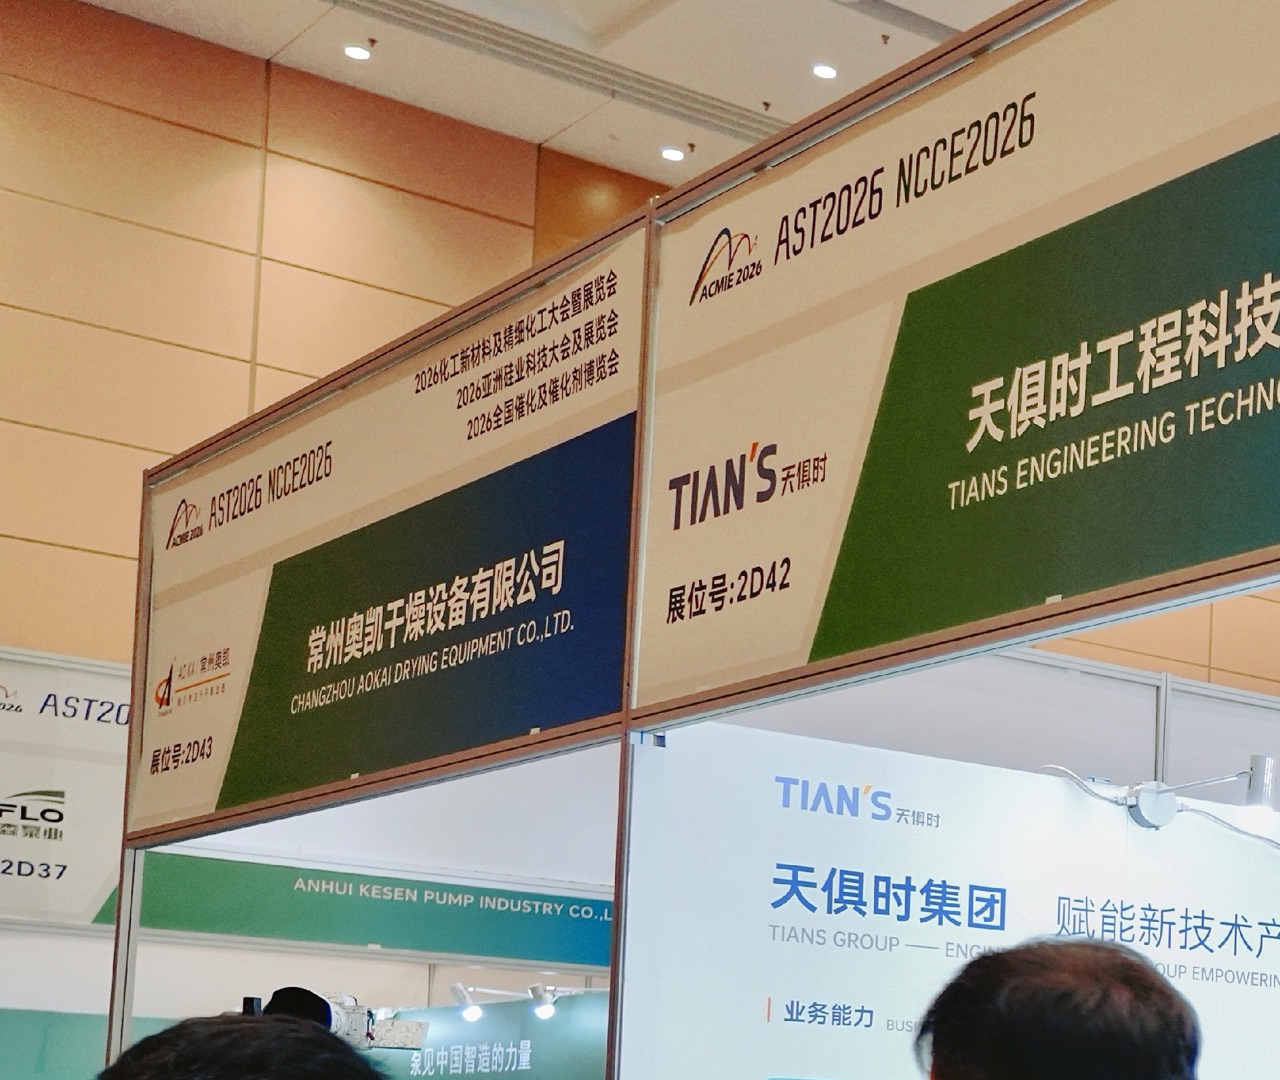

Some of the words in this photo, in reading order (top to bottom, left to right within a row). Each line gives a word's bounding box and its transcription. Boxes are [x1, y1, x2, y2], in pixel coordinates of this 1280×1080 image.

[774, 167, 887, 266] AST2026
[896, 91, 1037, 209] NCCE2026
[699, 276, 734, 303] ACMIE
[735, 260, 763, 288] 2026
[456, 309, 619, 409] 2026亚洲硅业科技大会及展览会
[467, 348, 620, 440] 2026全国催化及催化剂博览会
[208, 474, 263, 531] AST2026
[268, 440, 333, 504] NCCE2026
[780, 451, 828, 497] 天俱时
[948, 466, 1008, 510] TIANS
[1015, 410, 1176, 490] ENGINEERING
[306, 539, 565, 674] 常州奥凯干燥设备有限公司
[665, 556, 792, 625] 展位号:2D42
[290, 678, 355, 715] CHANGZHOU
[356, 664, 392, 693] AOKAI
[394, 651, 438, 684] DRYING
[441, 626, 515, 670] EQUIPMENT
[516, 609, 575, 646] CO.,LTD.
[150, 735, 213, 776] 展位号:2D43
[895, 807, 941, 829] 天俱时
[1, 859, 68, 880] 2D37
[293, 877, 353, 896] ANHUI
[359, 883, 418, 903] KESEN
[423, 889, 475, 907] PUMP
[479, 895, 564, 917] INDUSTRY
[770, 862, 1008, 932] 天俱时集团
[768, 924, 827, 945] TIANS
[833, 930, 900, 952] GROUP
[783, 1000, 874, 1029] 业务能力
